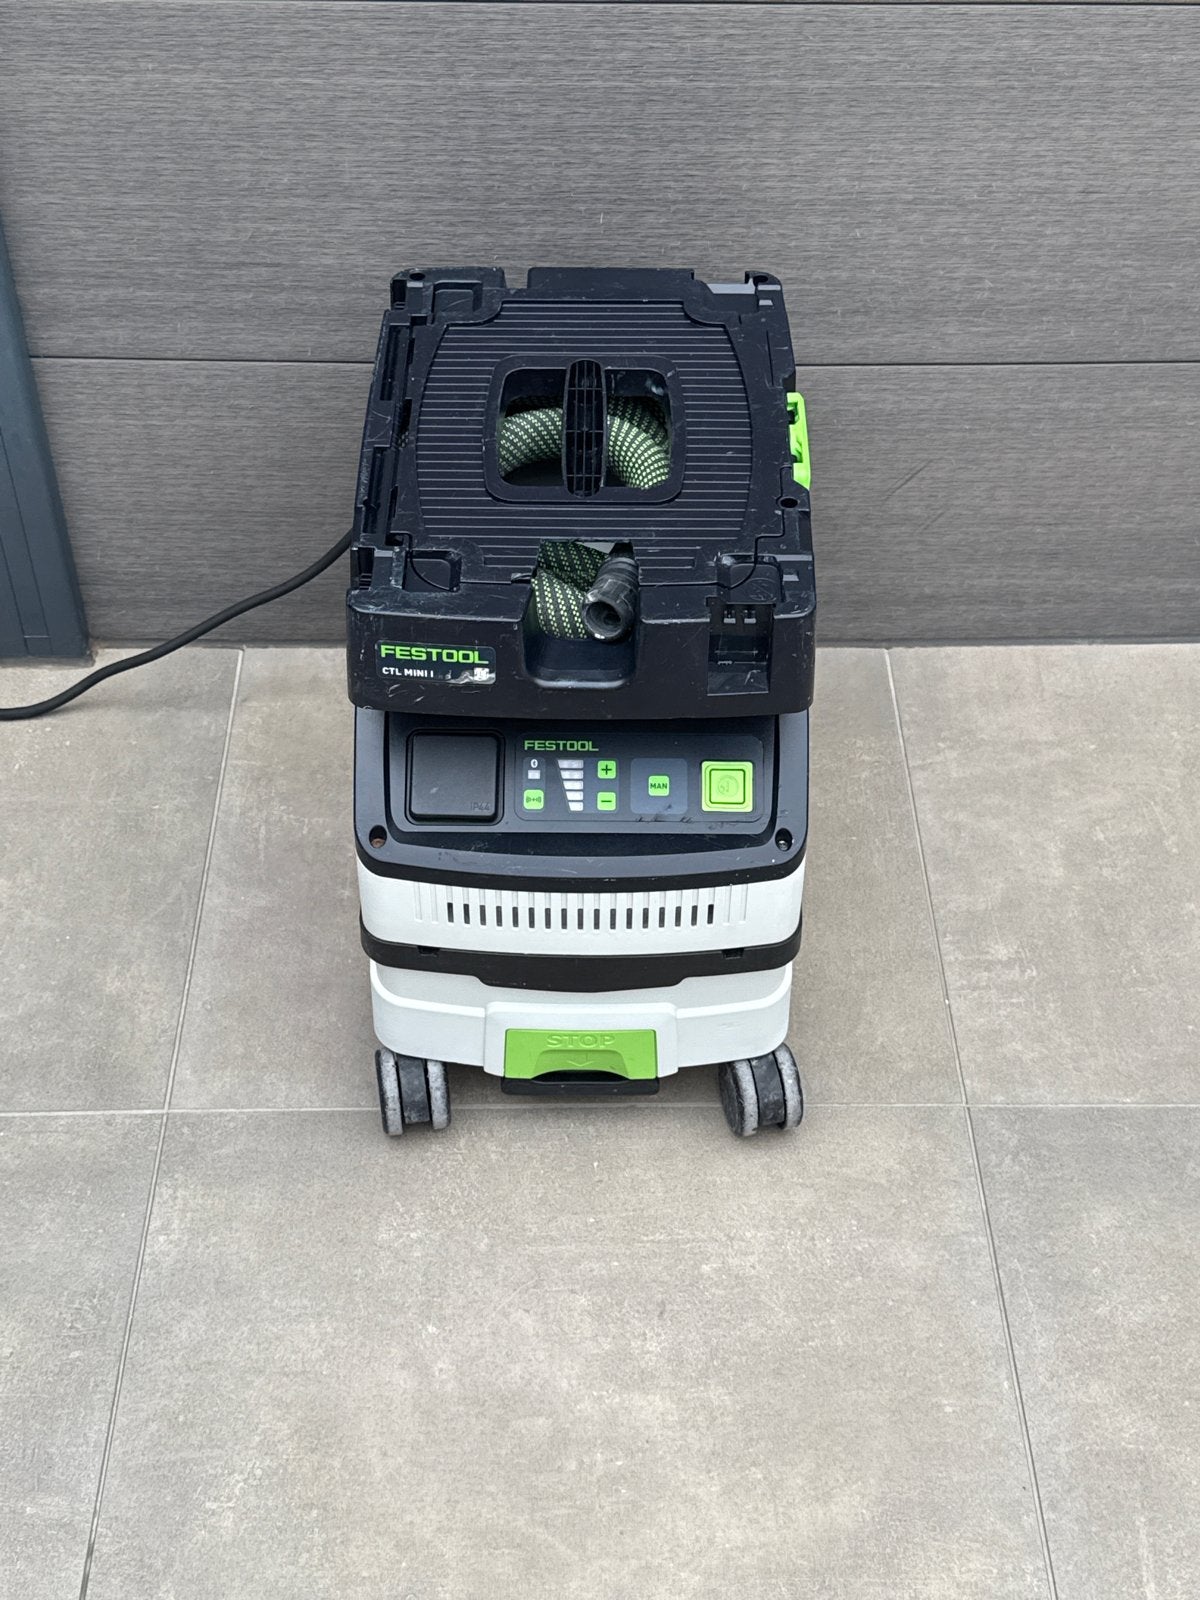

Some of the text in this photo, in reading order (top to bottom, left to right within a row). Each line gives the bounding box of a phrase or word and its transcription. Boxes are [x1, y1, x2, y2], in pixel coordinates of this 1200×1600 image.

[380, 645, 489, 664] FESTOOL
[382, 667, 402, 675] CTL
[404, 668, 428, 677] MINI
[524, 741, 599, 751] FESTOOL
[650, 782, 668, 790] MAN
[546, 1034, 615, 1048] STOP
